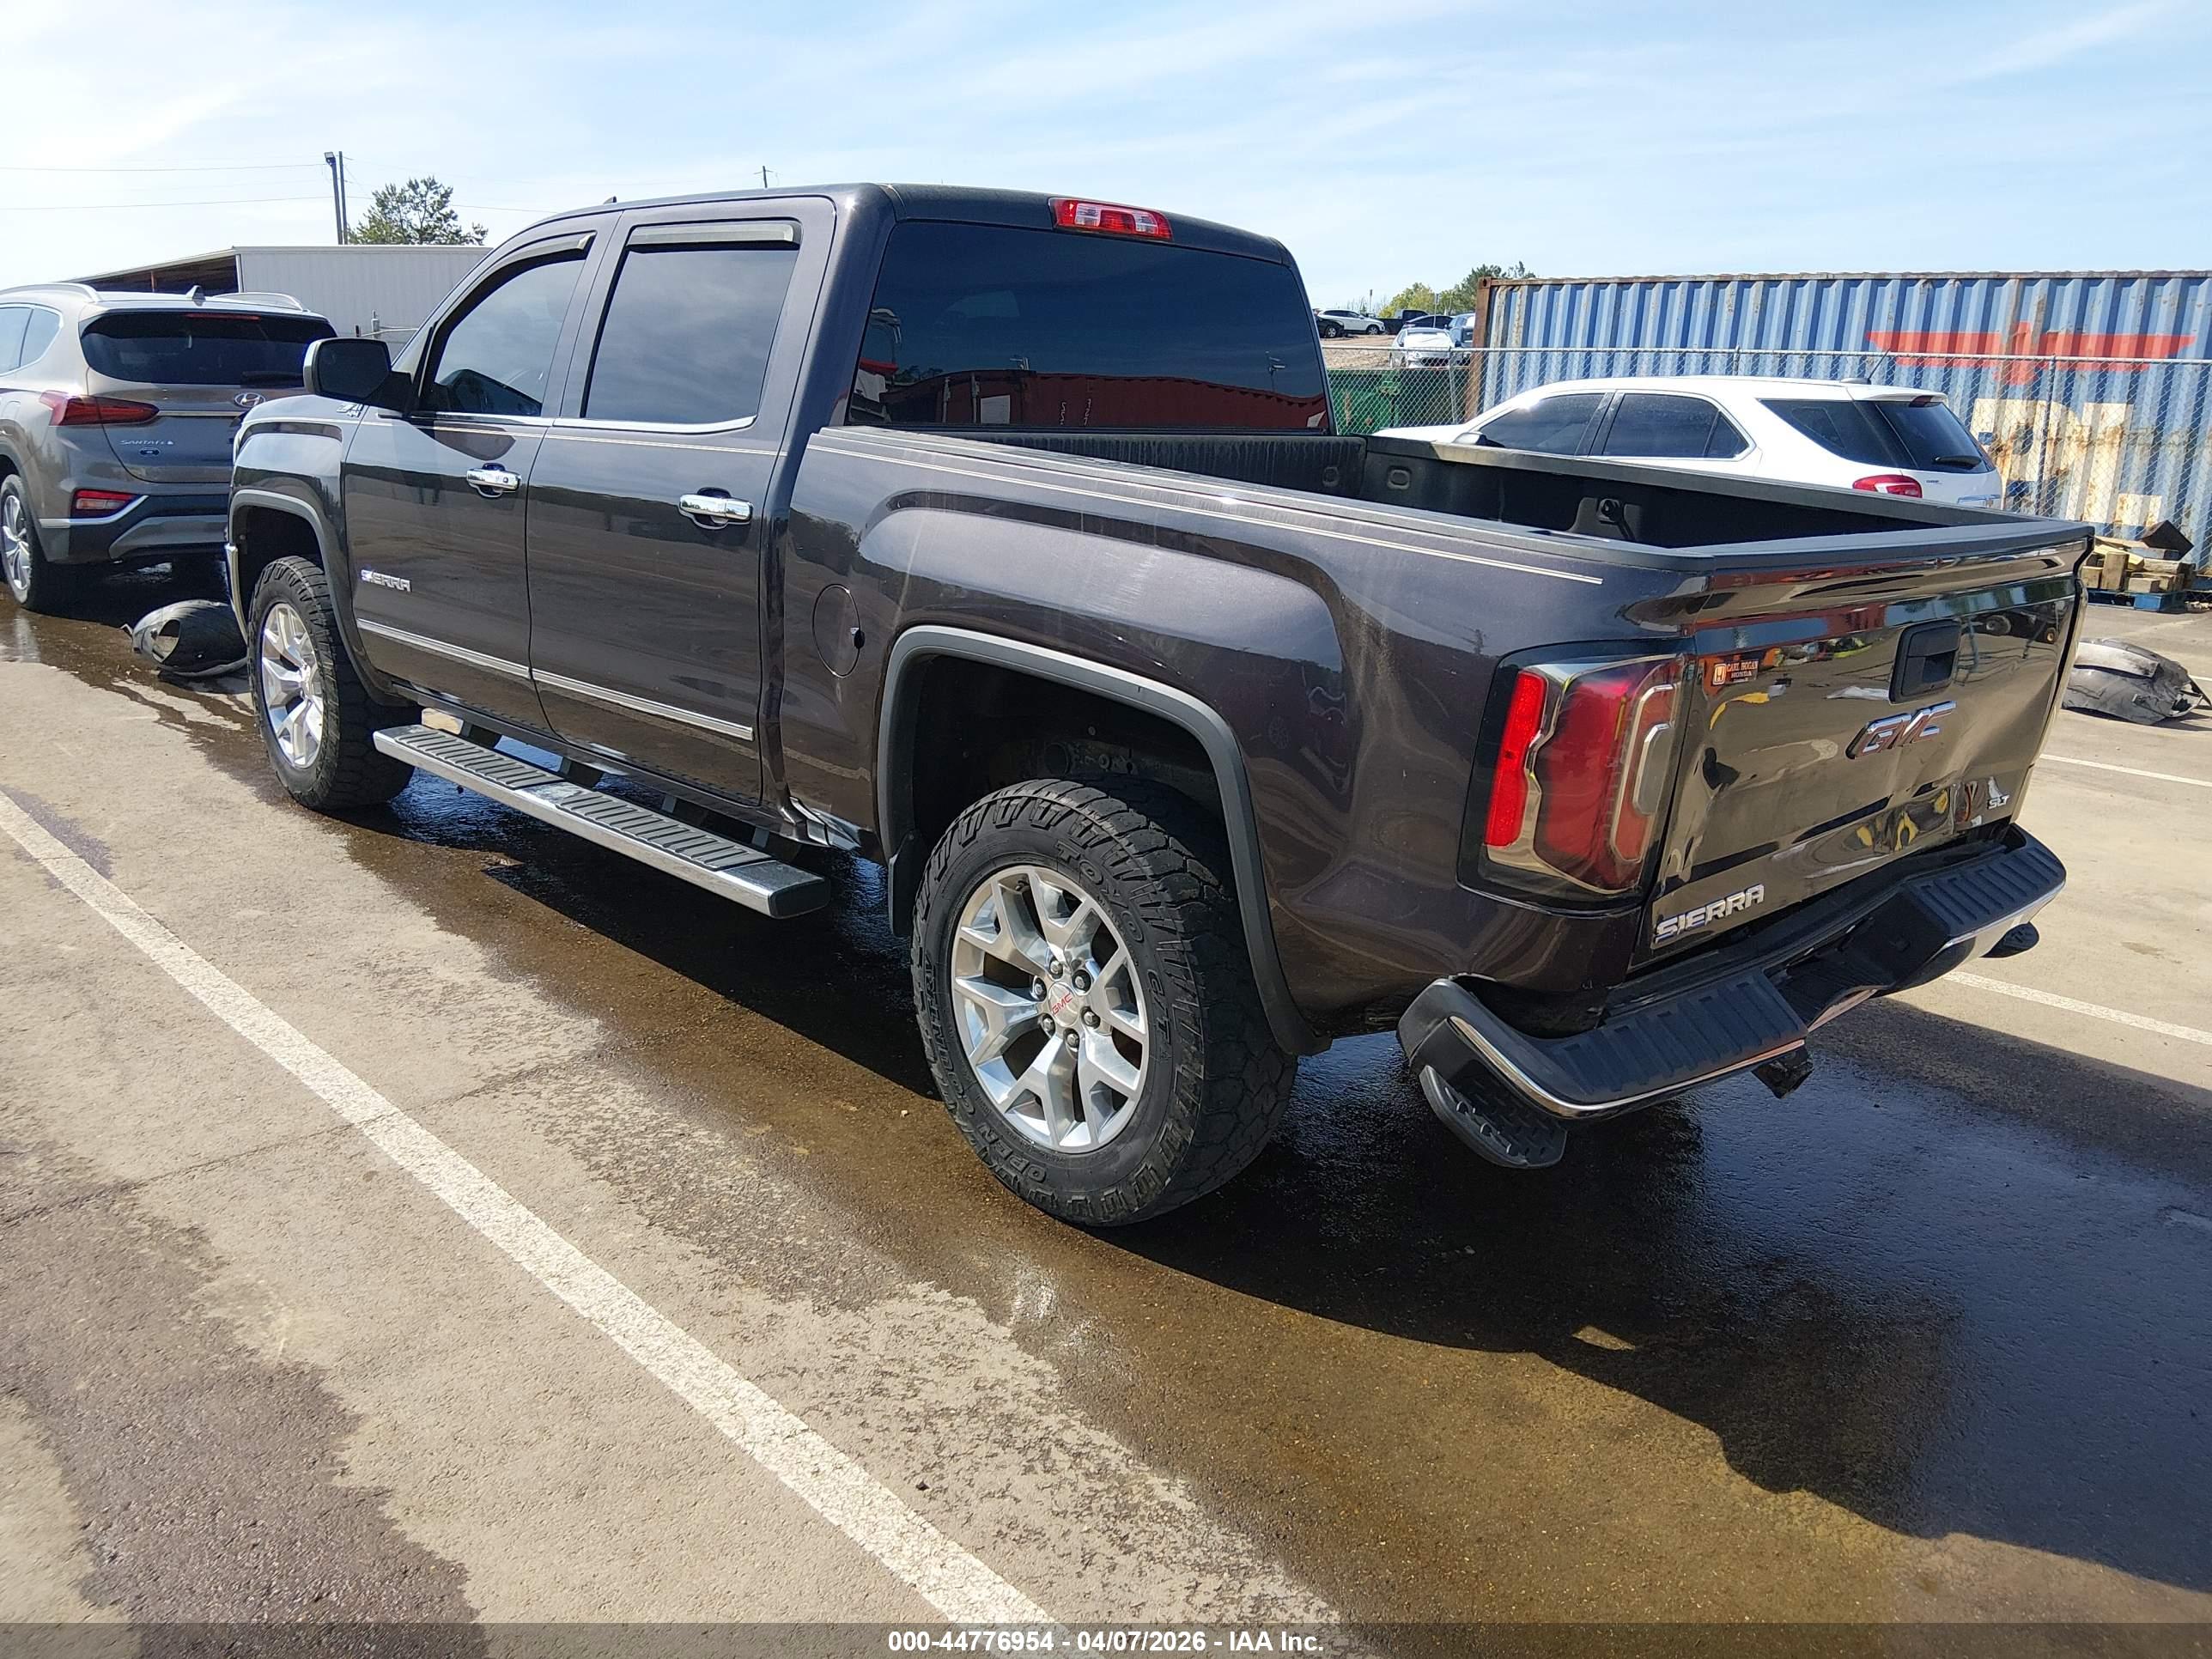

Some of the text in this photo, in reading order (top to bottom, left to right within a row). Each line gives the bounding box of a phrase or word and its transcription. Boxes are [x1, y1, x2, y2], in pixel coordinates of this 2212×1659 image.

[361, 569, 411, 592] SIERRA
[1846, 700, 1958, 759] GMC
[1987, 794, 2010, 810] SLT
[1055, 839, 1146, 943] TOYO
[1655, 883, 1765, 945] SIERRA
[923, 952, 977, 1115] COUNTRY
[1052, 992, 1073, 1015] GMC
[976, 1121, 1048, 1184] OPEN
